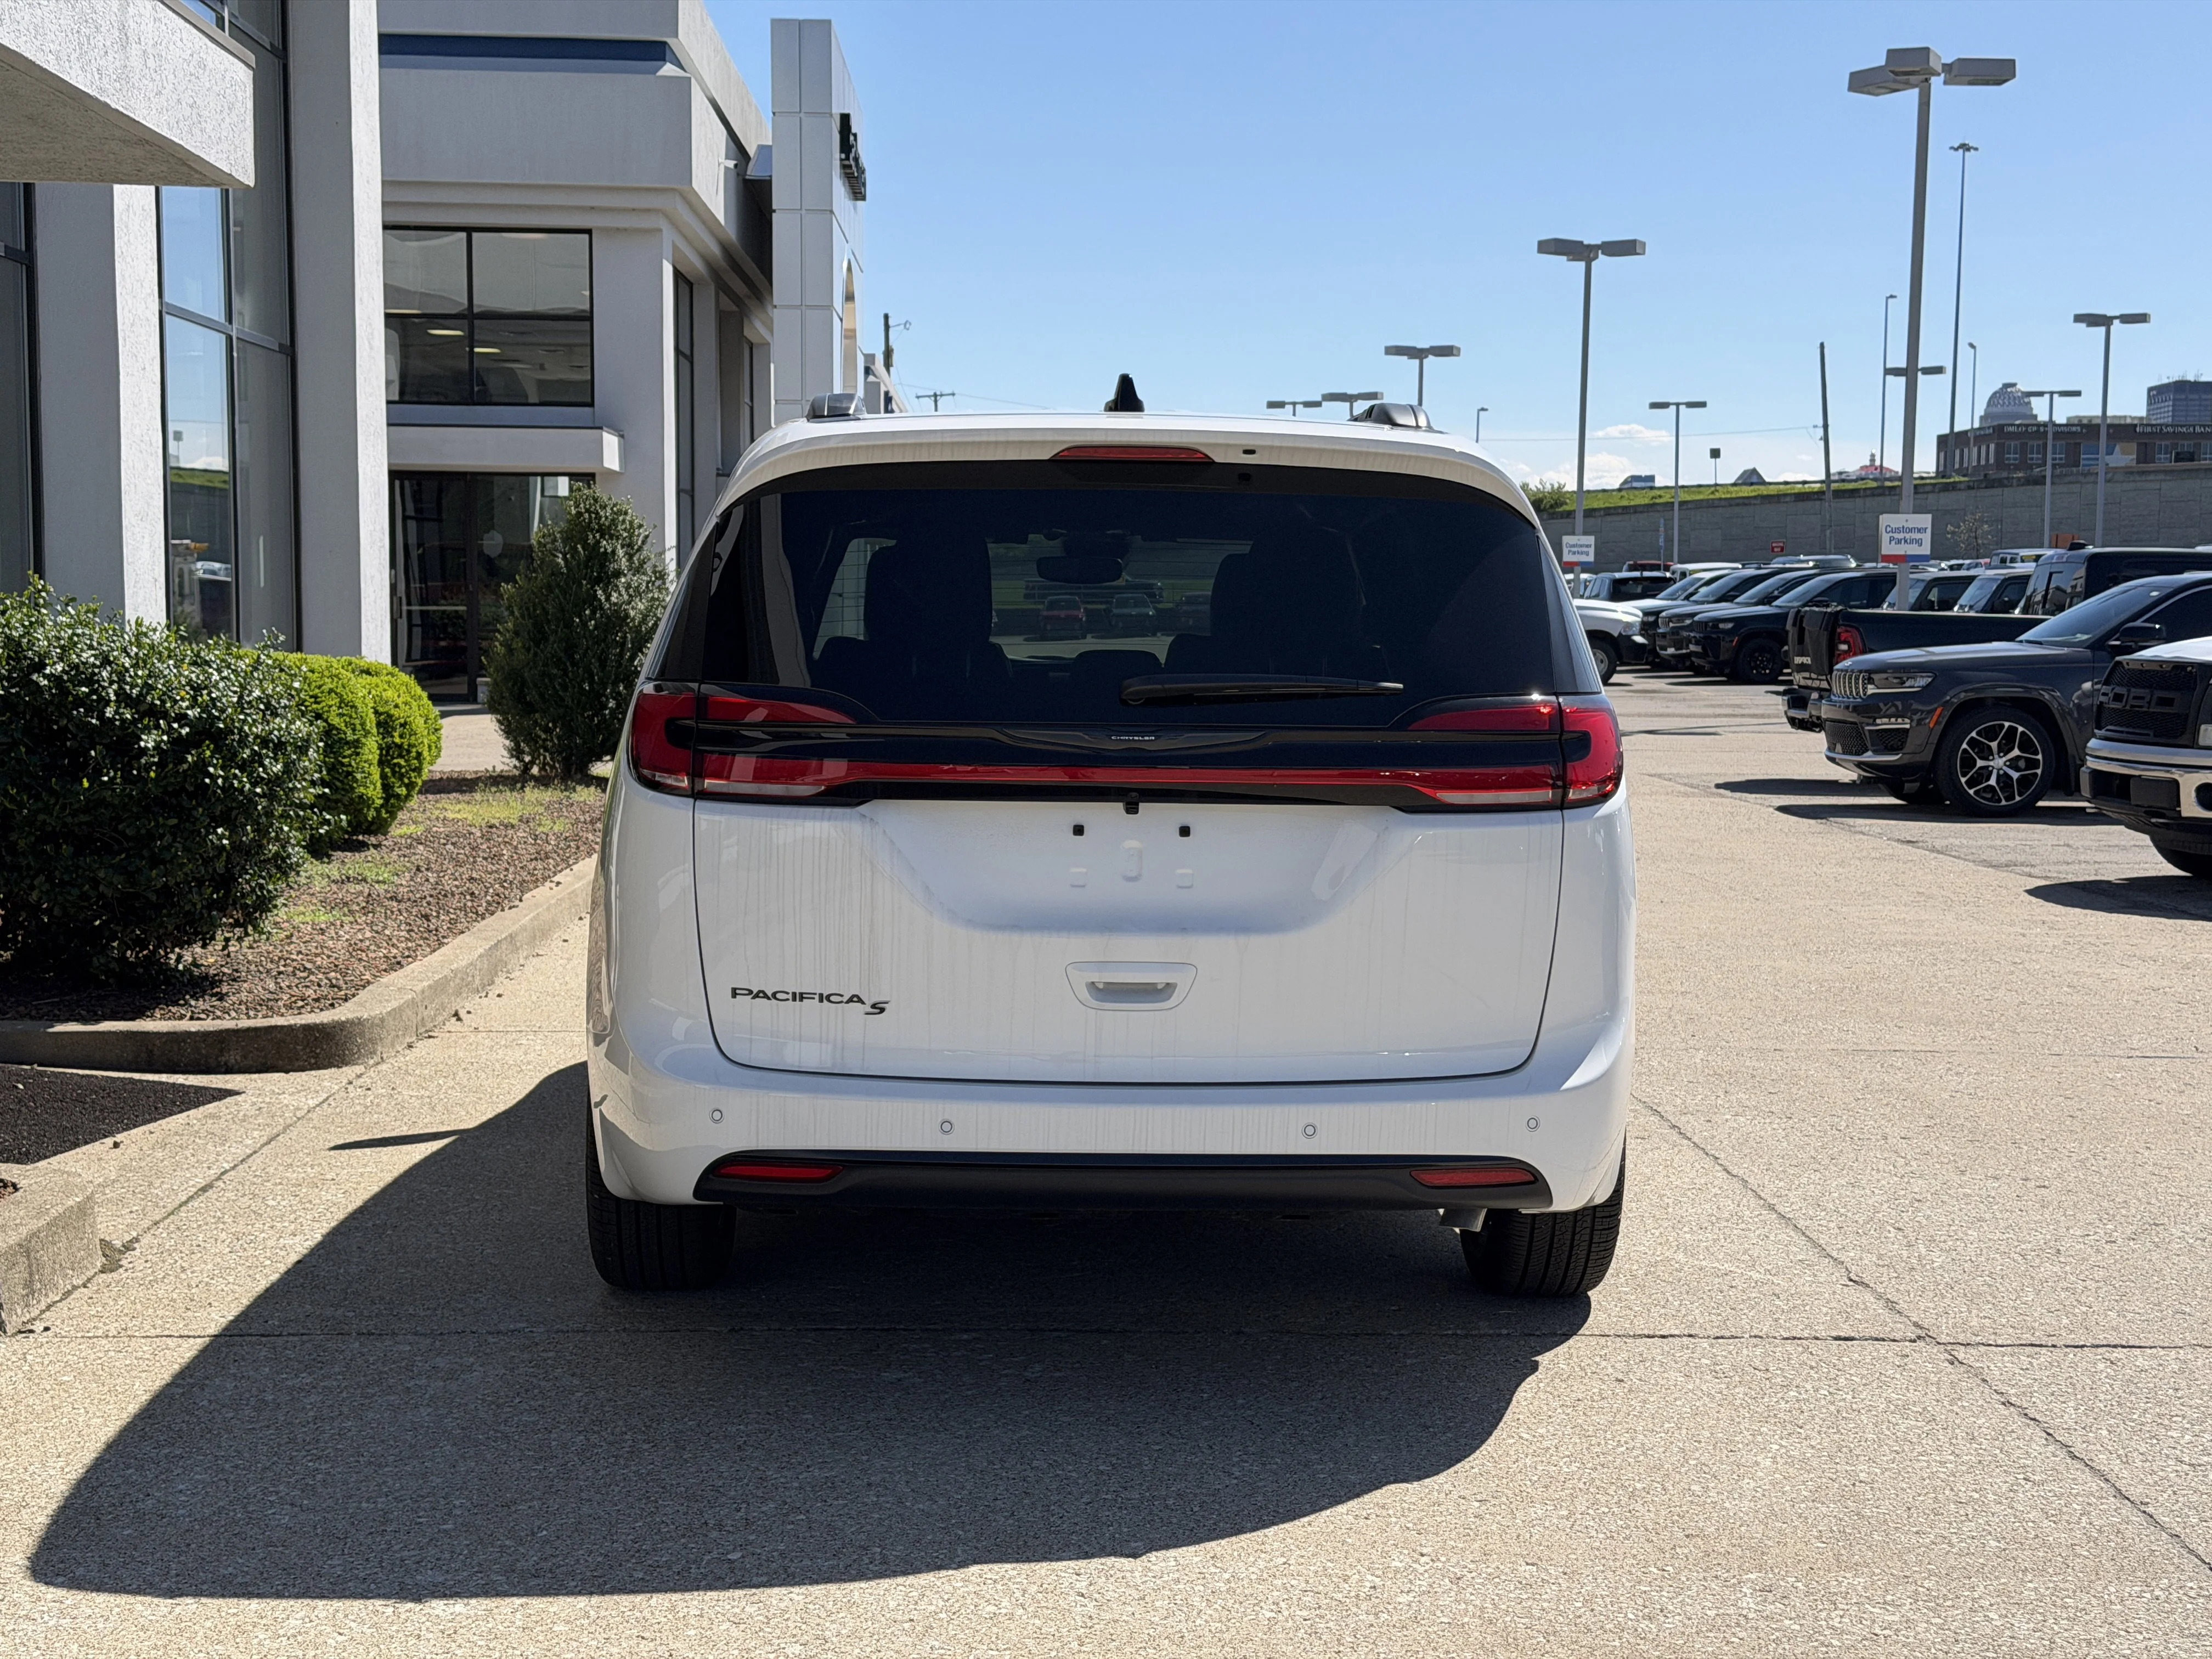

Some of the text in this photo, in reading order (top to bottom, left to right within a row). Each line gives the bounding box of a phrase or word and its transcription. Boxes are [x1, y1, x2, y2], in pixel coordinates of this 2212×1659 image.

[2194, 425, 2212, 433] BAN
[1884, 524, 1928, 534] Customer
[1888, 535, 1923, 547] Parking
[731, 987, 891, 1016] PACIFICA S
